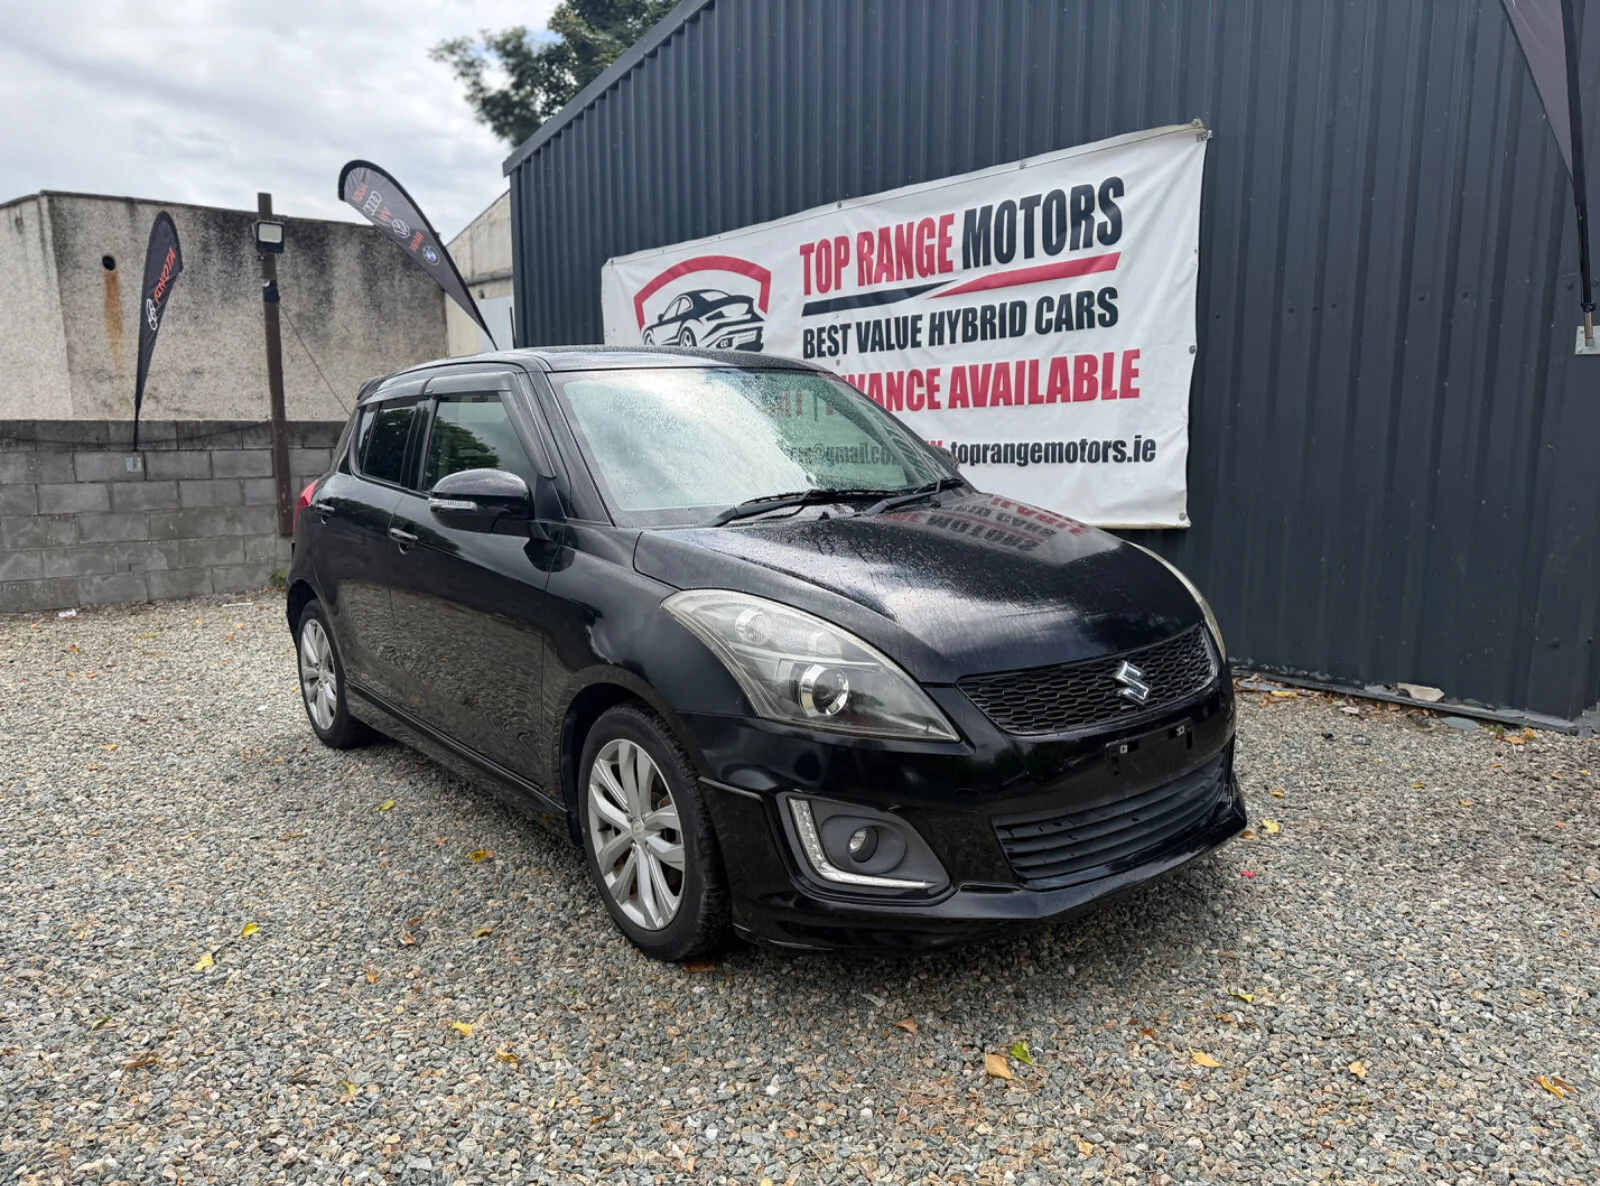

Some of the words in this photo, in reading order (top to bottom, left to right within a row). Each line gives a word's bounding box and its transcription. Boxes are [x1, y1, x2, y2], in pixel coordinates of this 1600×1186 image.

[800, 236, 850, 296] TOP
[857, 213, 955, 287] RANGE
[962, 177, 1125, 270] MOTORS
[803, 323, 852, 359] BEST
[856, 314, 923, 353] VALUE
[929, 300, 1028, 347] HYBRID
[1035, 287, 1119, 336] CARS
[839, 368, 942, 412] ANCE
[948, 348, 1141, 409] AVAILABLE
